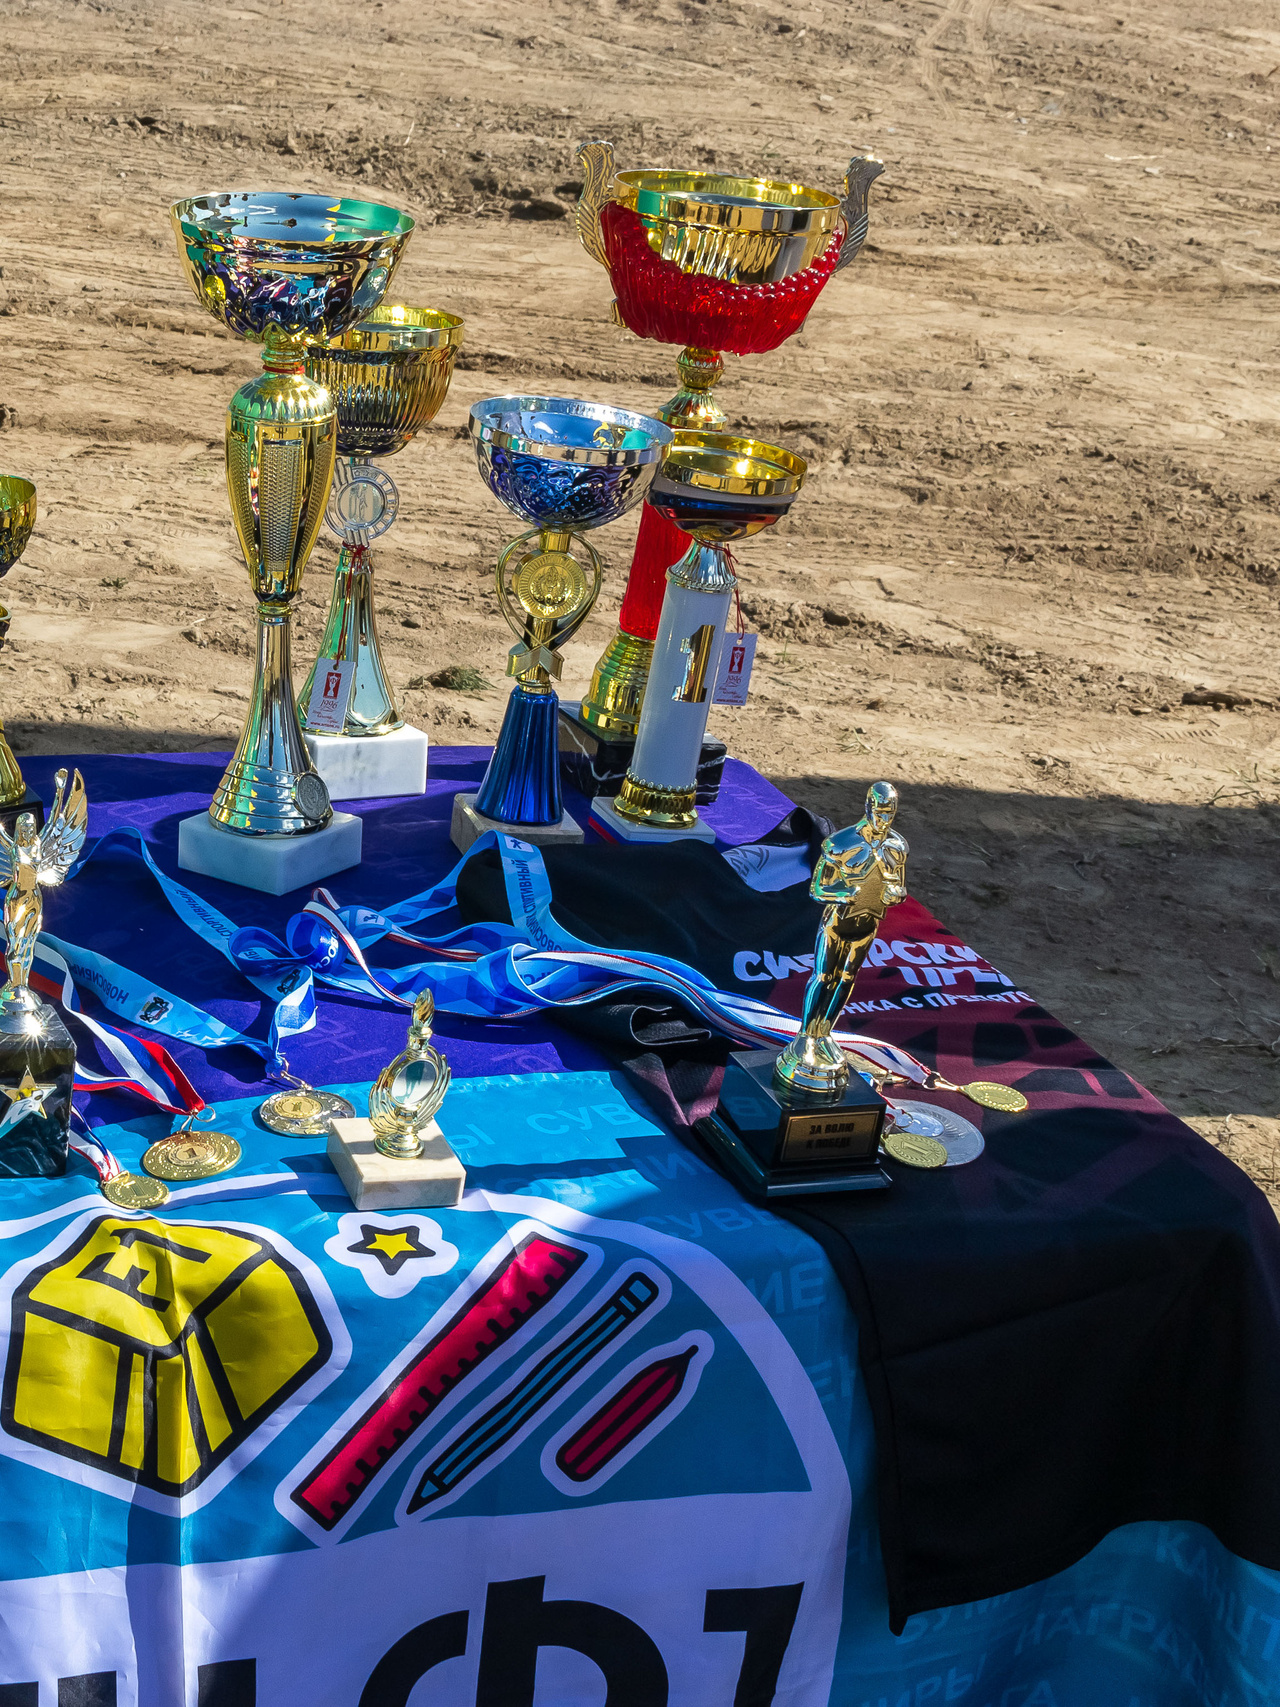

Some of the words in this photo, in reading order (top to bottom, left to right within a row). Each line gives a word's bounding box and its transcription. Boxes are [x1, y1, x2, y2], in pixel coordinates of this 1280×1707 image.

[671, 624, 716, 703] 1
[900, 996, 924, 1009] С
[809, 1124, 822, 1135] ЗА
[824, 1122, 855, 1134] ВОЛЮ
